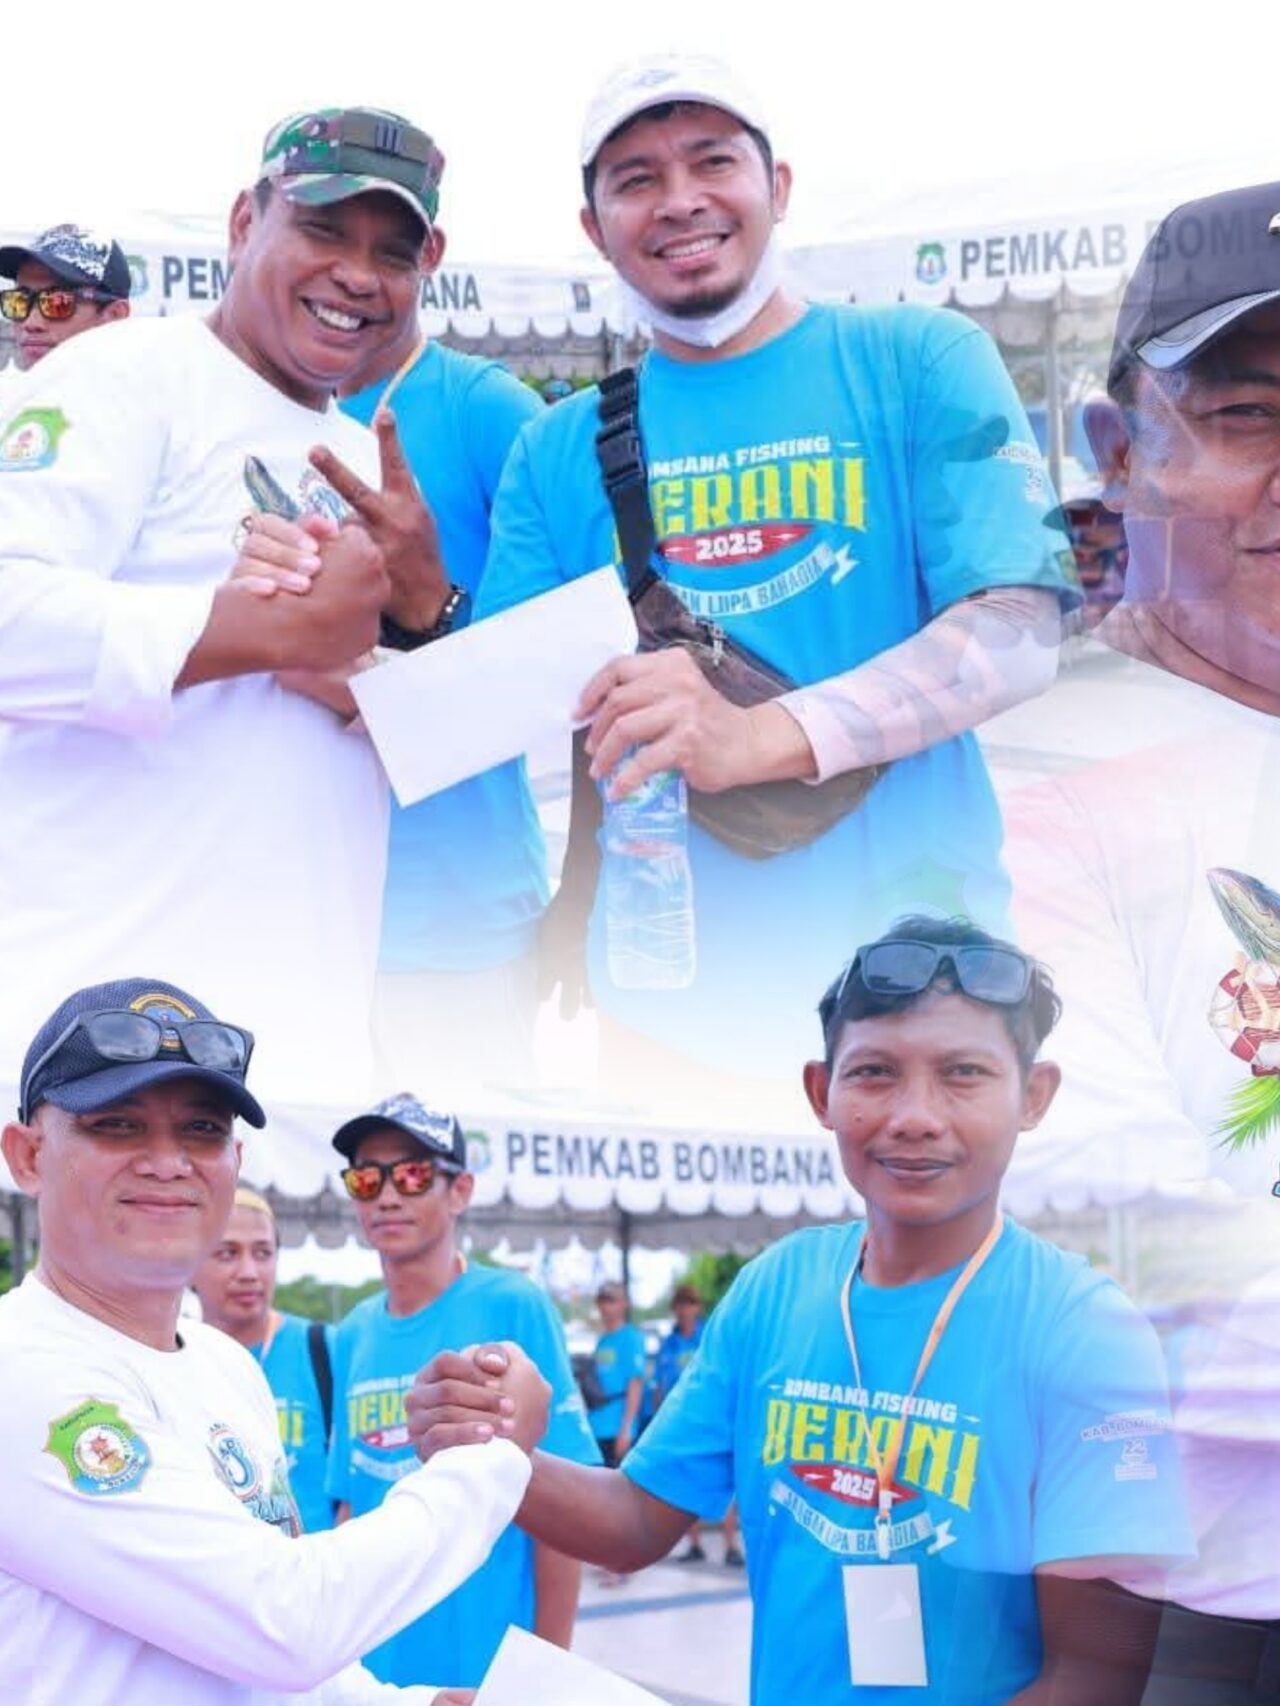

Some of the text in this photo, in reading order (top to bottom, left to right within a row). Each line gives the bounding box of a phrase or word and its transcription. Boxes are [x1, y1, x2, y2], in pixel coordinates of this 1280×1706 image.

[959, 222, 1128, 281] PEMKAB
[162, 255, 234, 300] PEM
[735, 436, 831, 466] FISHING
[652, 458, 867, 540] ERANI
[696, 530, 764, 562] 2025
[506, 1132, 836, 1187] PEMKAB BOMBANA
[872, 1391, 959, 1423] FISHING
[762, 1399, 981, 1513] BERANI
[830, 1468, 877, 1501] 2025
